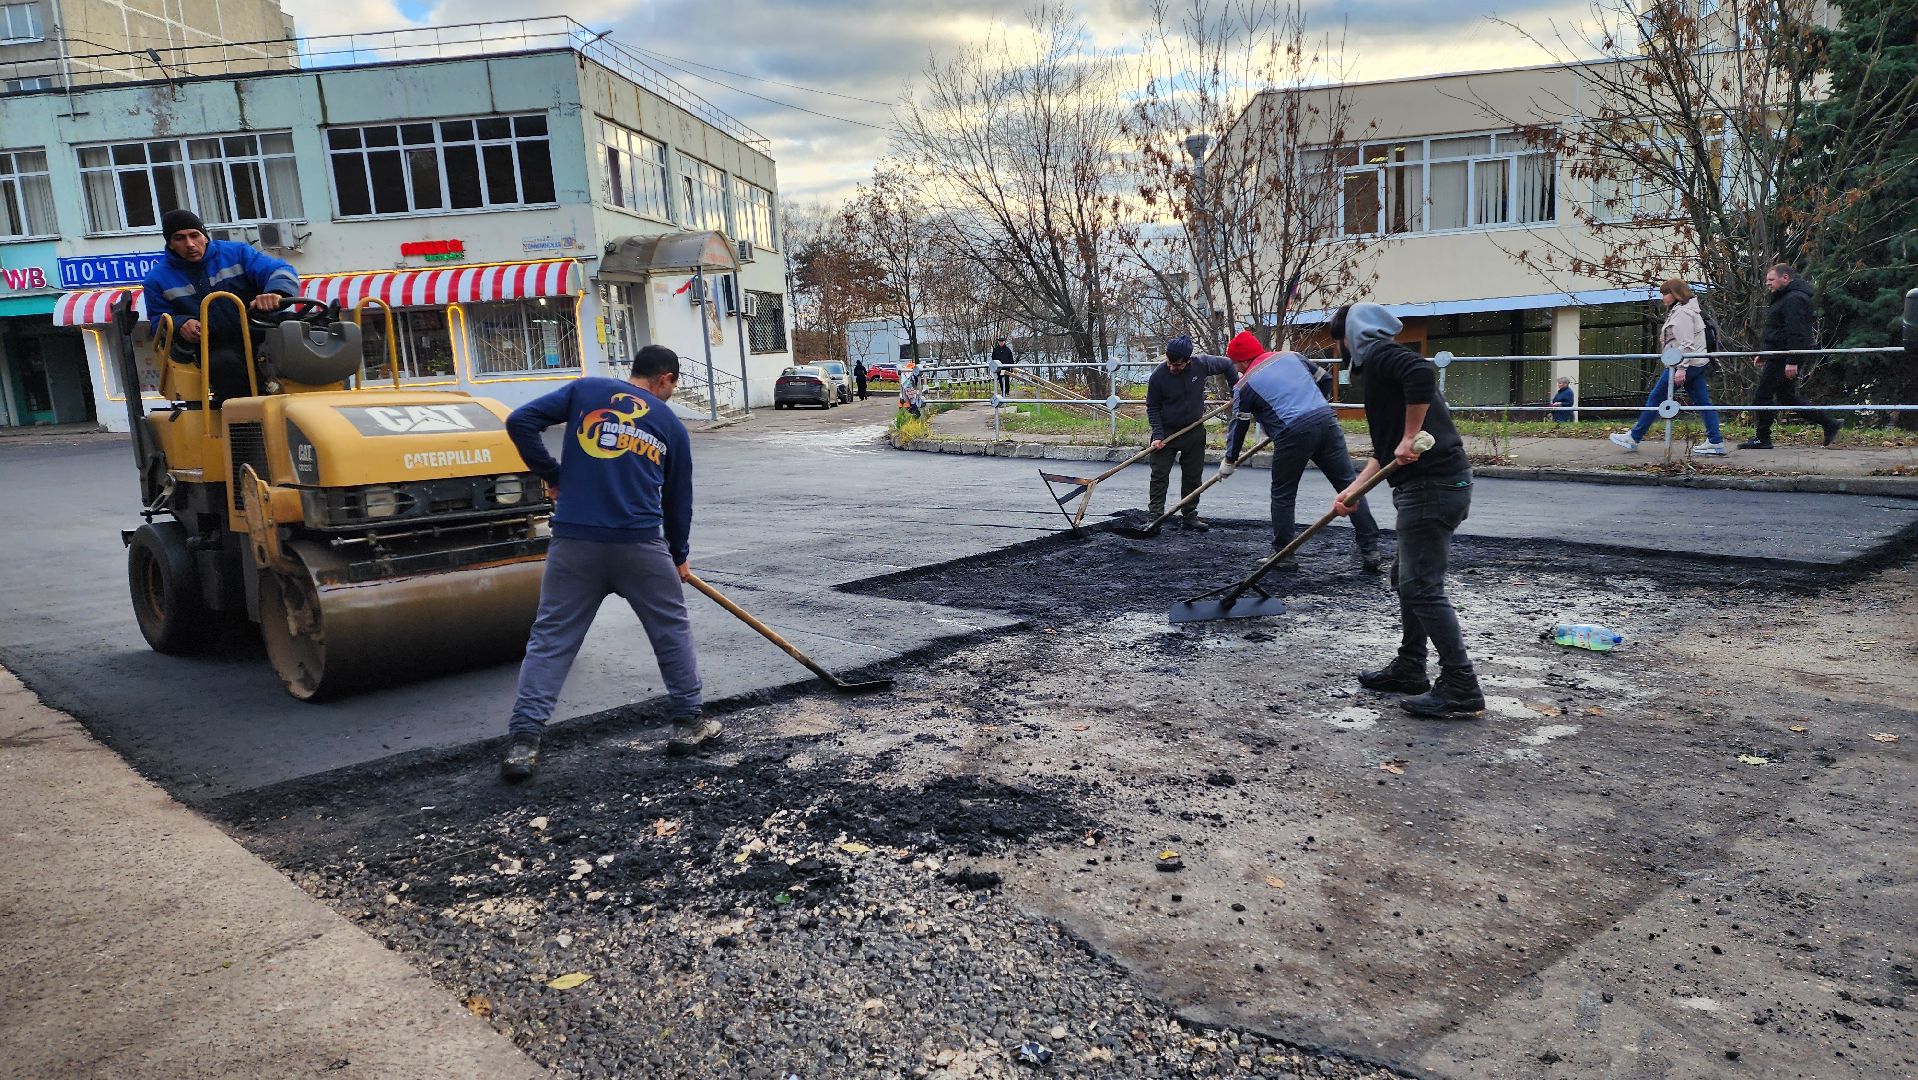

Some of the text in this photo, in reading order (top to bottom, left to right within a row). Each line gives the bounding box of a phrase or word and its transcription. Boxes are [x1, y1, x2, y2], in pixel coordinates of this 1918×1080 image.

[2, 266, 47, 290] WB
[364, 404, 477, 432] CAT
[298, 443, 312, 461] CAT
[403, 448, 492, 469] CATERPILLAR
